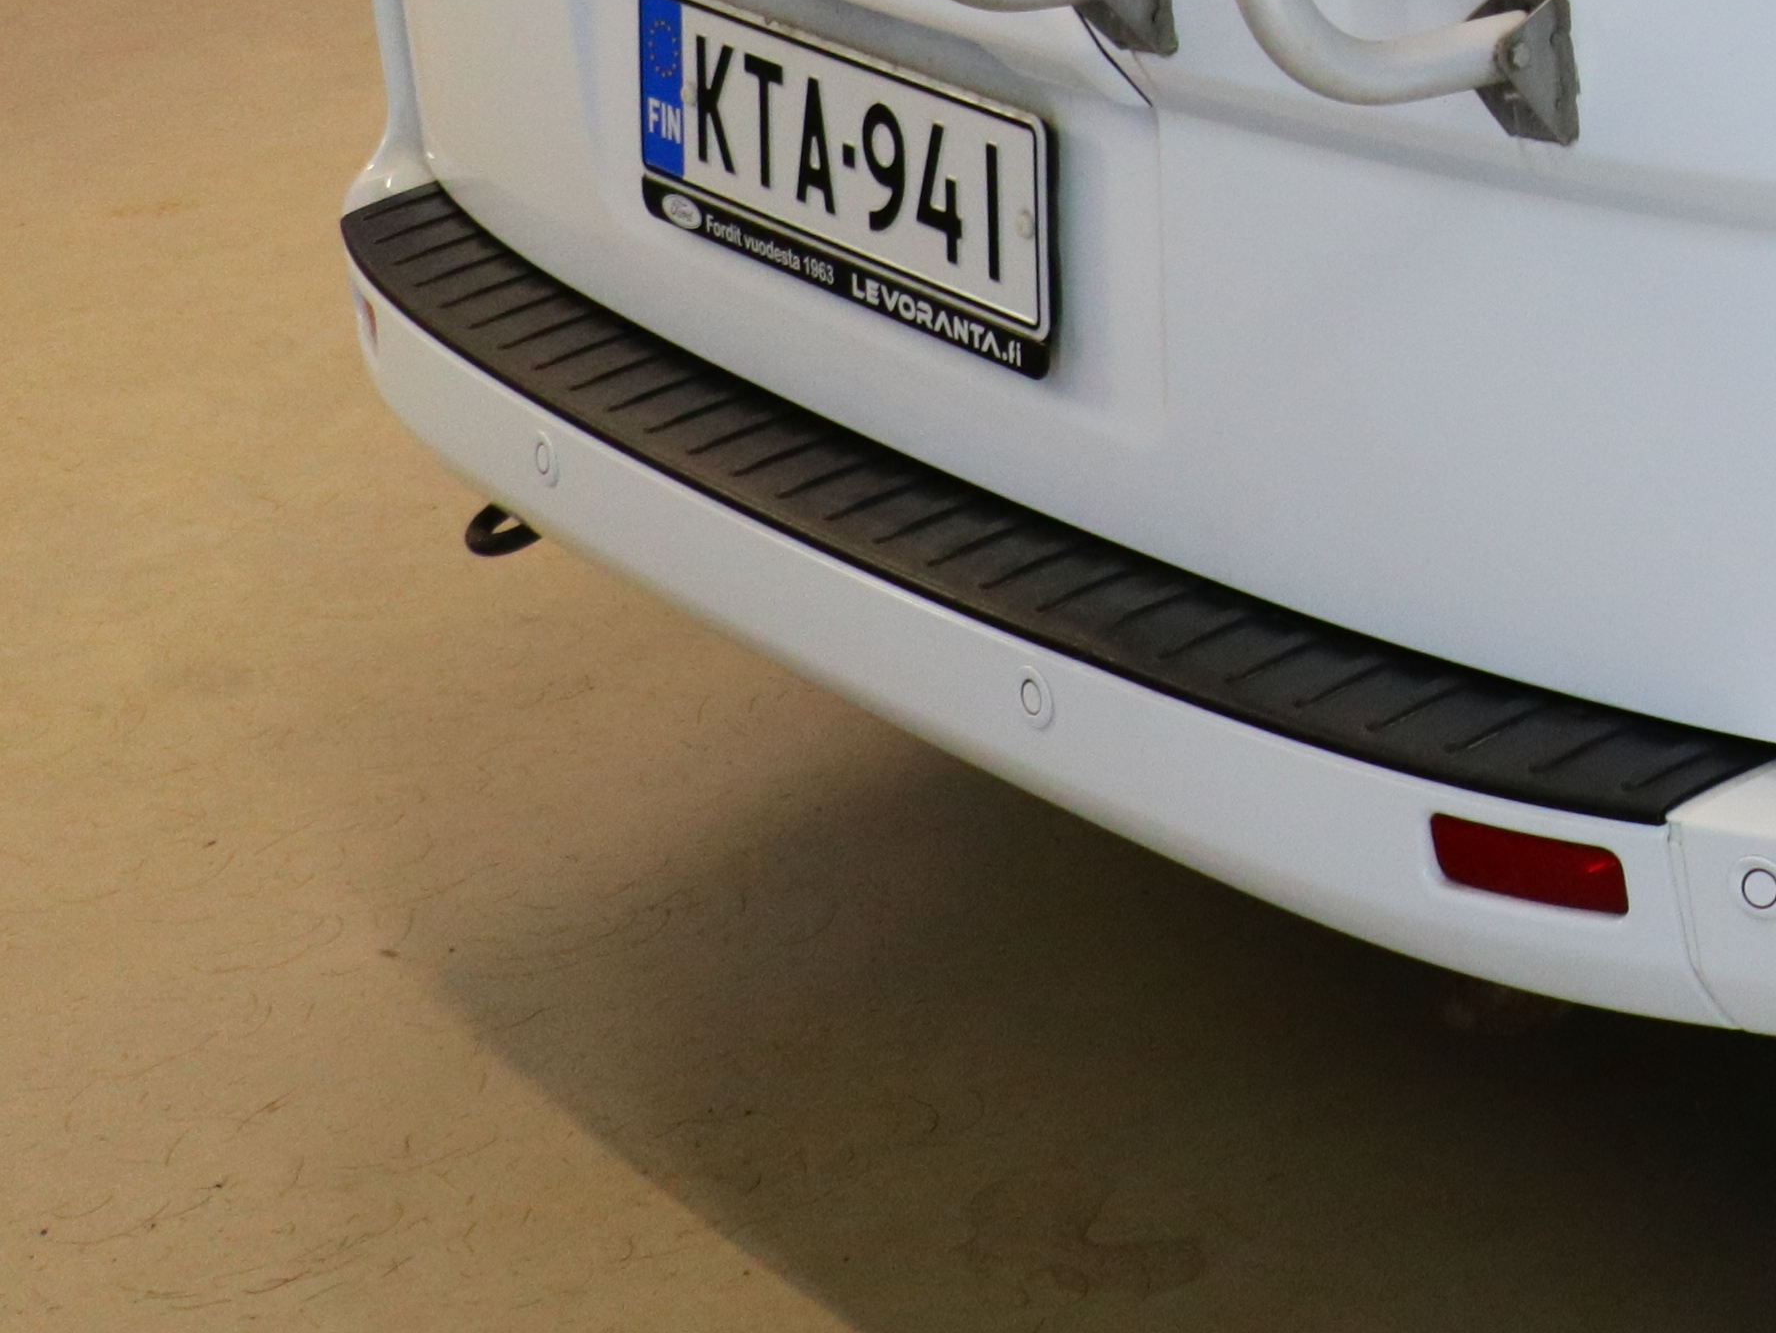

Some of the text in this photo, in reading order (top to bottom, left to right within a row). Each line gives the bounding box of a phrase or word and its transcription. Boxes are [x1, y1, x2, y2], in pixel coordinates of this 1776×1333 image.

[647, 97, 682, 144] FIN
[695, 34, 1001, 283] KTA-941
[705, 214, 835, 285] Fordit vuodesta 1963
[851, 272, 1022, 367] LEVORANTA.fi
